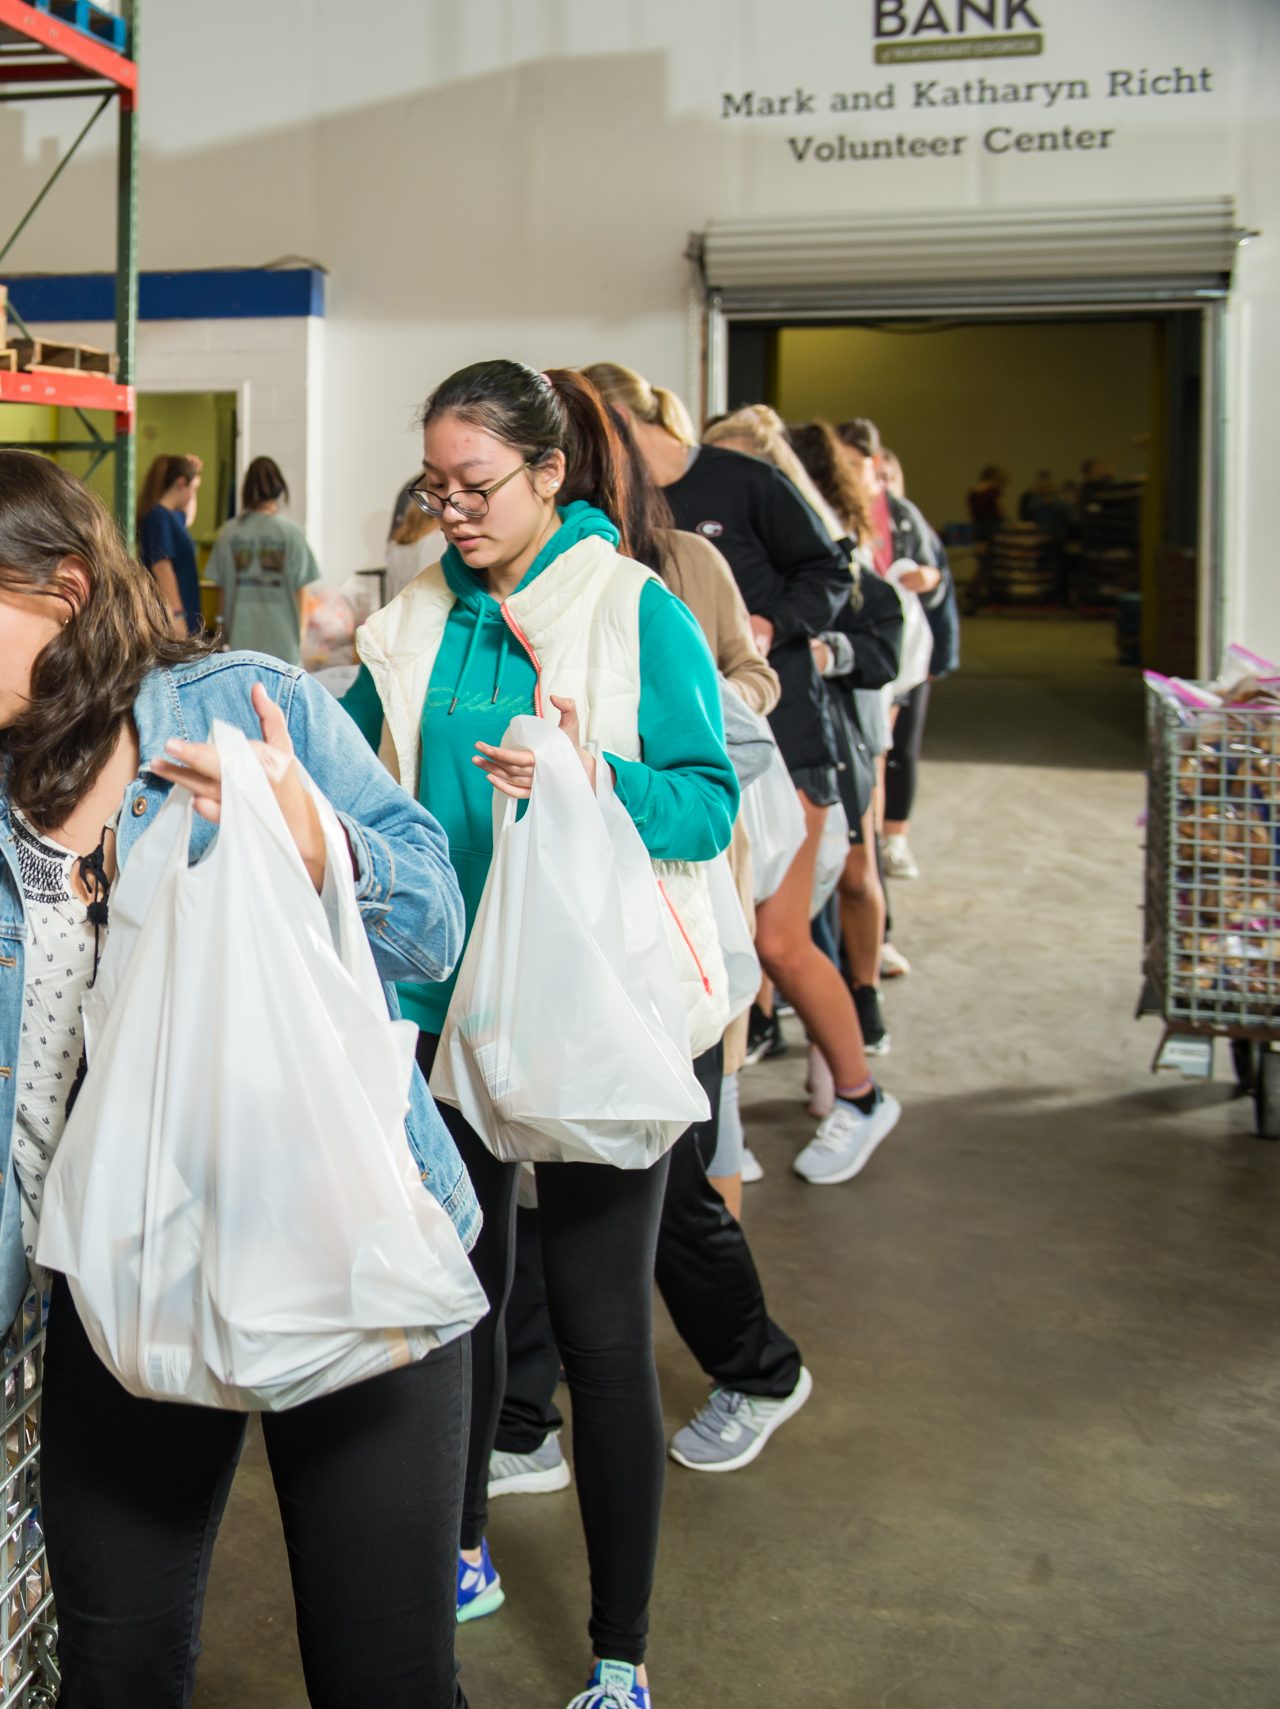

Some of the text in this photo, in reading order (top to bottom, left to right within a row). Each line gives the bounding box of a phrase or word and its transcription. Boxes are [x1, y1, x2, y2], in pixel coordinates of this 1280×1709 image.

[873, 0, 1041, 38] BANK
[721, 66, 1215, 119] Mark and Katharyn Richt
[787, 125, 1117, 163] Volunteer Center
